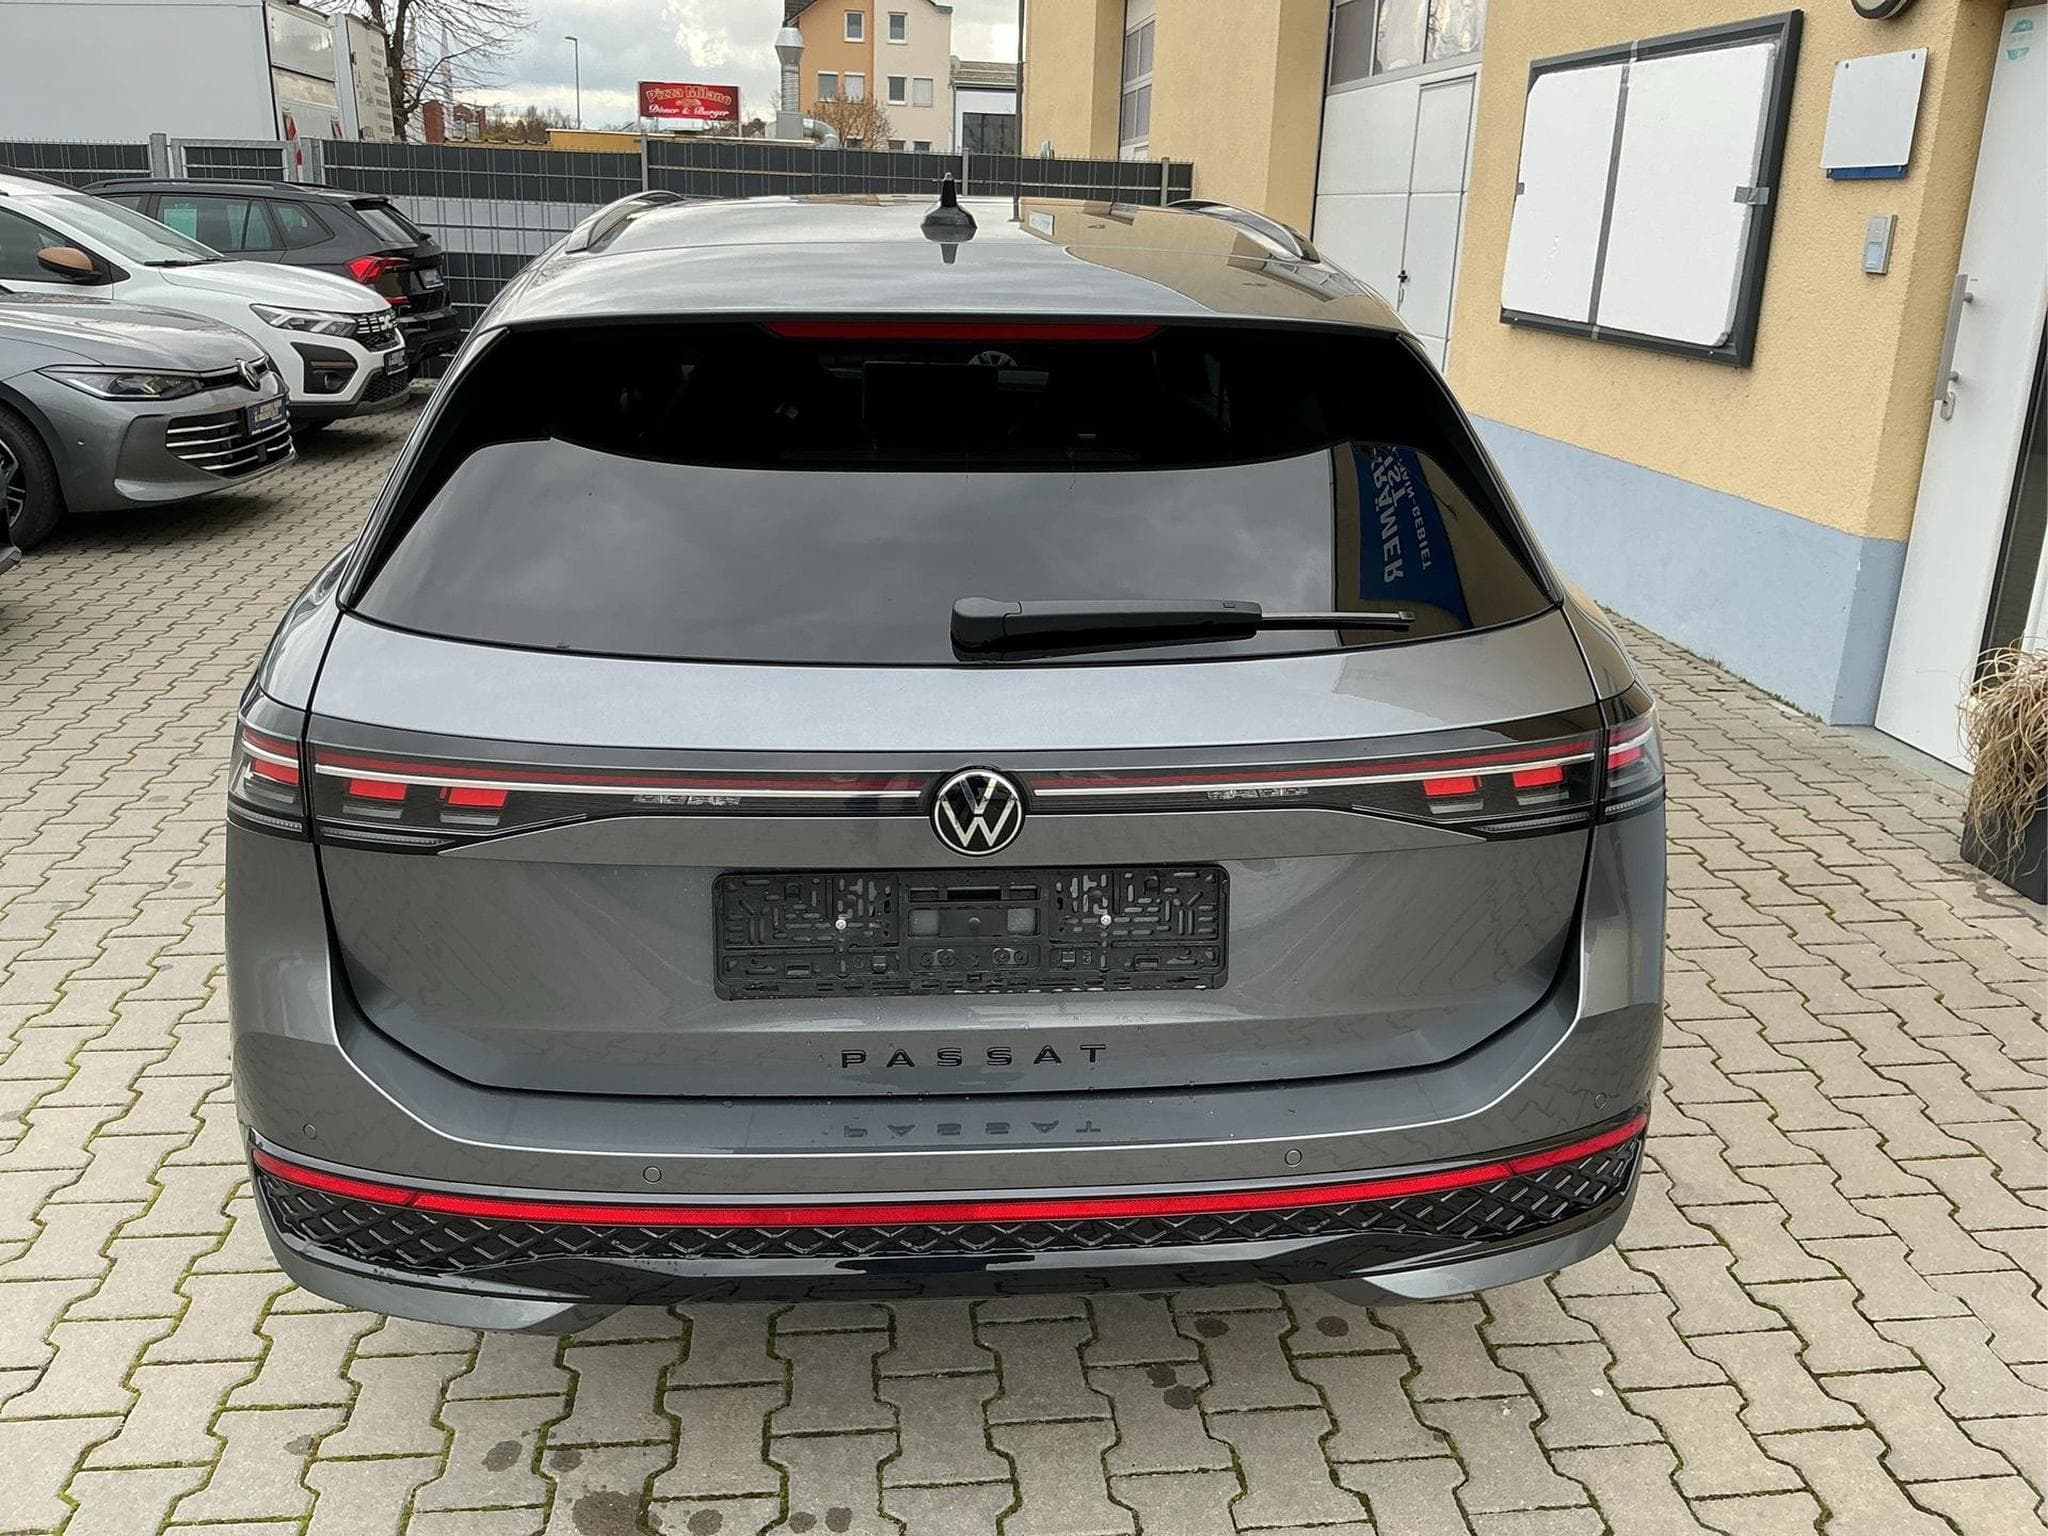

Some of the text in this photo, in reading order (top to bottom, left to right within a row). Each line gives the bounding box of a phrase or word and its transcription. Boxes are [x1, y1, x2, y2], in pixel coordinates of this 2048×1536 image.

[645, 86, 732, 106] Pizza Milano
[694, 106, 729, 118] Burger
[937, 771, 1020, 851] VW
[840, 1044, 1106, 1068] PASSAT
